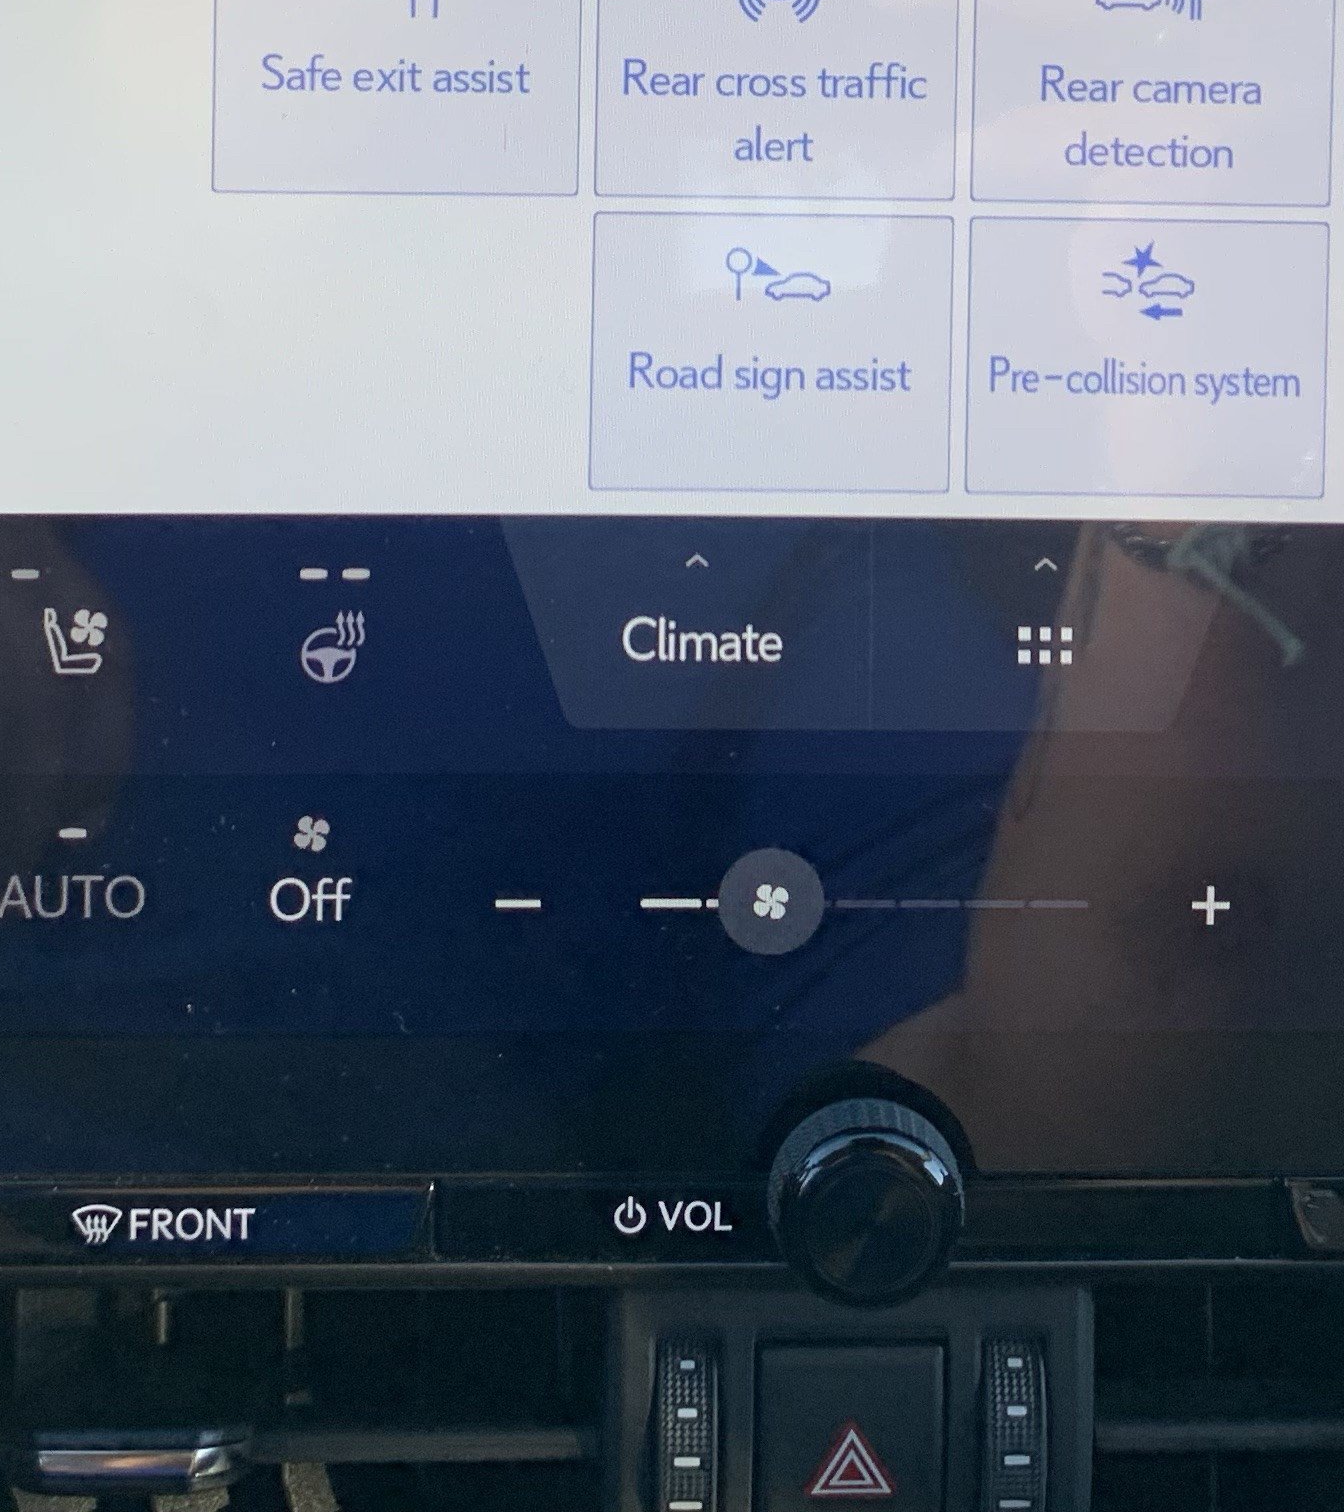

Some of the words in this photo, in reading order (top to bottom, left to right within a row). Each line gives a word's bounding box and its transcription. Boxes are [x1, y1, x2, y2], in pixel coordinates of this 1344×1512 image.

[262, 54, 342, 91] Safe
[353, 59, 422, 92] exit
[433, 60, 530, 93] assist
[624, 59, 702, 96] Rear
[716, 74, 806, 97] cross
[818, 62, 927, 99] traffic
[1041, 65, 1123, 102] Rear
[1133, 81, 1261, 104] camera
[735, 125, 813, 161] alert
[1065, 131, 1233, 168] detection
[630, 352, 722, 389] Road
[735, 357, 805, 400] sign
[816, 358, 911, 391] assist
[990, 356, 1185, 395] Pre-collision
[1195, 367, 1300, 405] system
[623, 616, 782, 662] Climate
[270, 878, 352, 921] Off
[130, 1208, 255, 1240] FRONT
[658, 1201, 732, 1231] VOL
